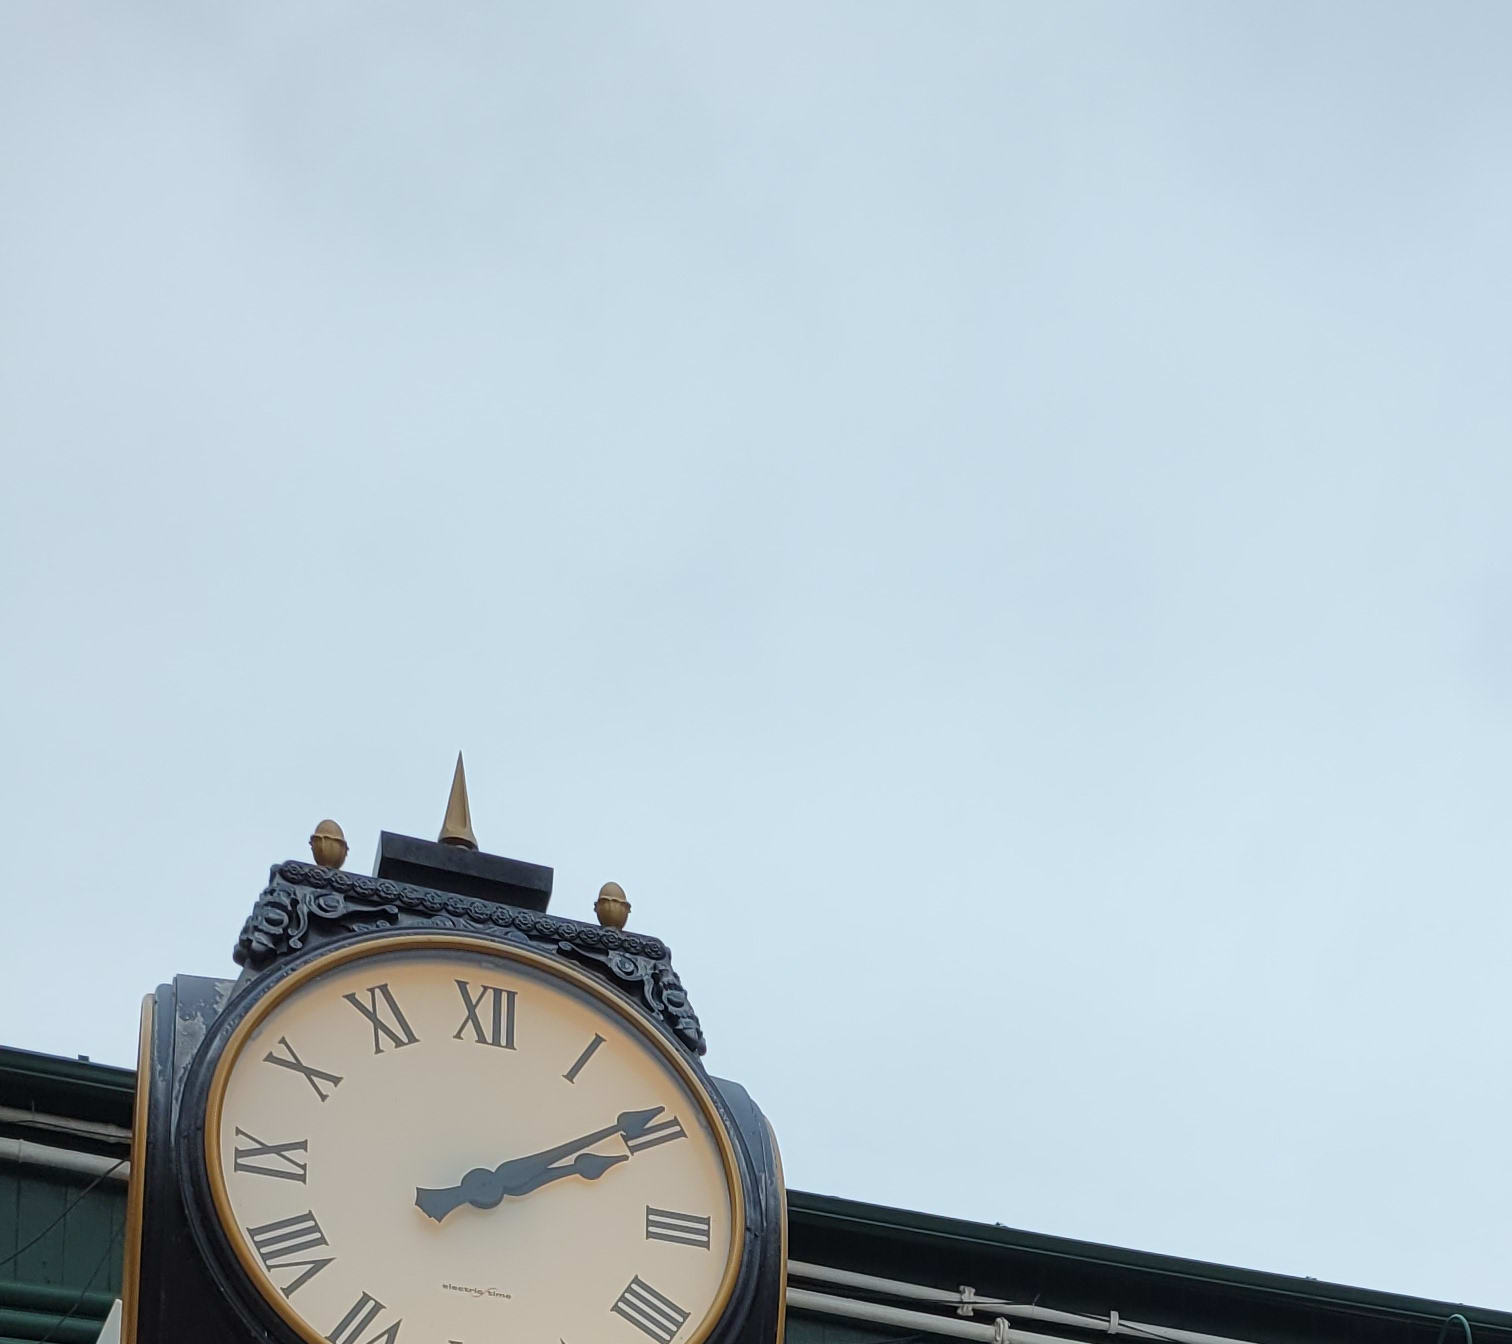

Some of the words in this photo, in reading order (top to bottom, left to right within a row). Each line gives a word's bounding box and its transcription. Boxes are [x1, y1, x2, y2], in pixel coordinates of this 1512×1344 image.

[342, 983, 421, 1055] XI
[453, 979, 518, 1050] XII
[262, 1036, 344, 1102] X
[442, 1283, 484, 1296] electric
[487, 1288, 512, 1300] time
